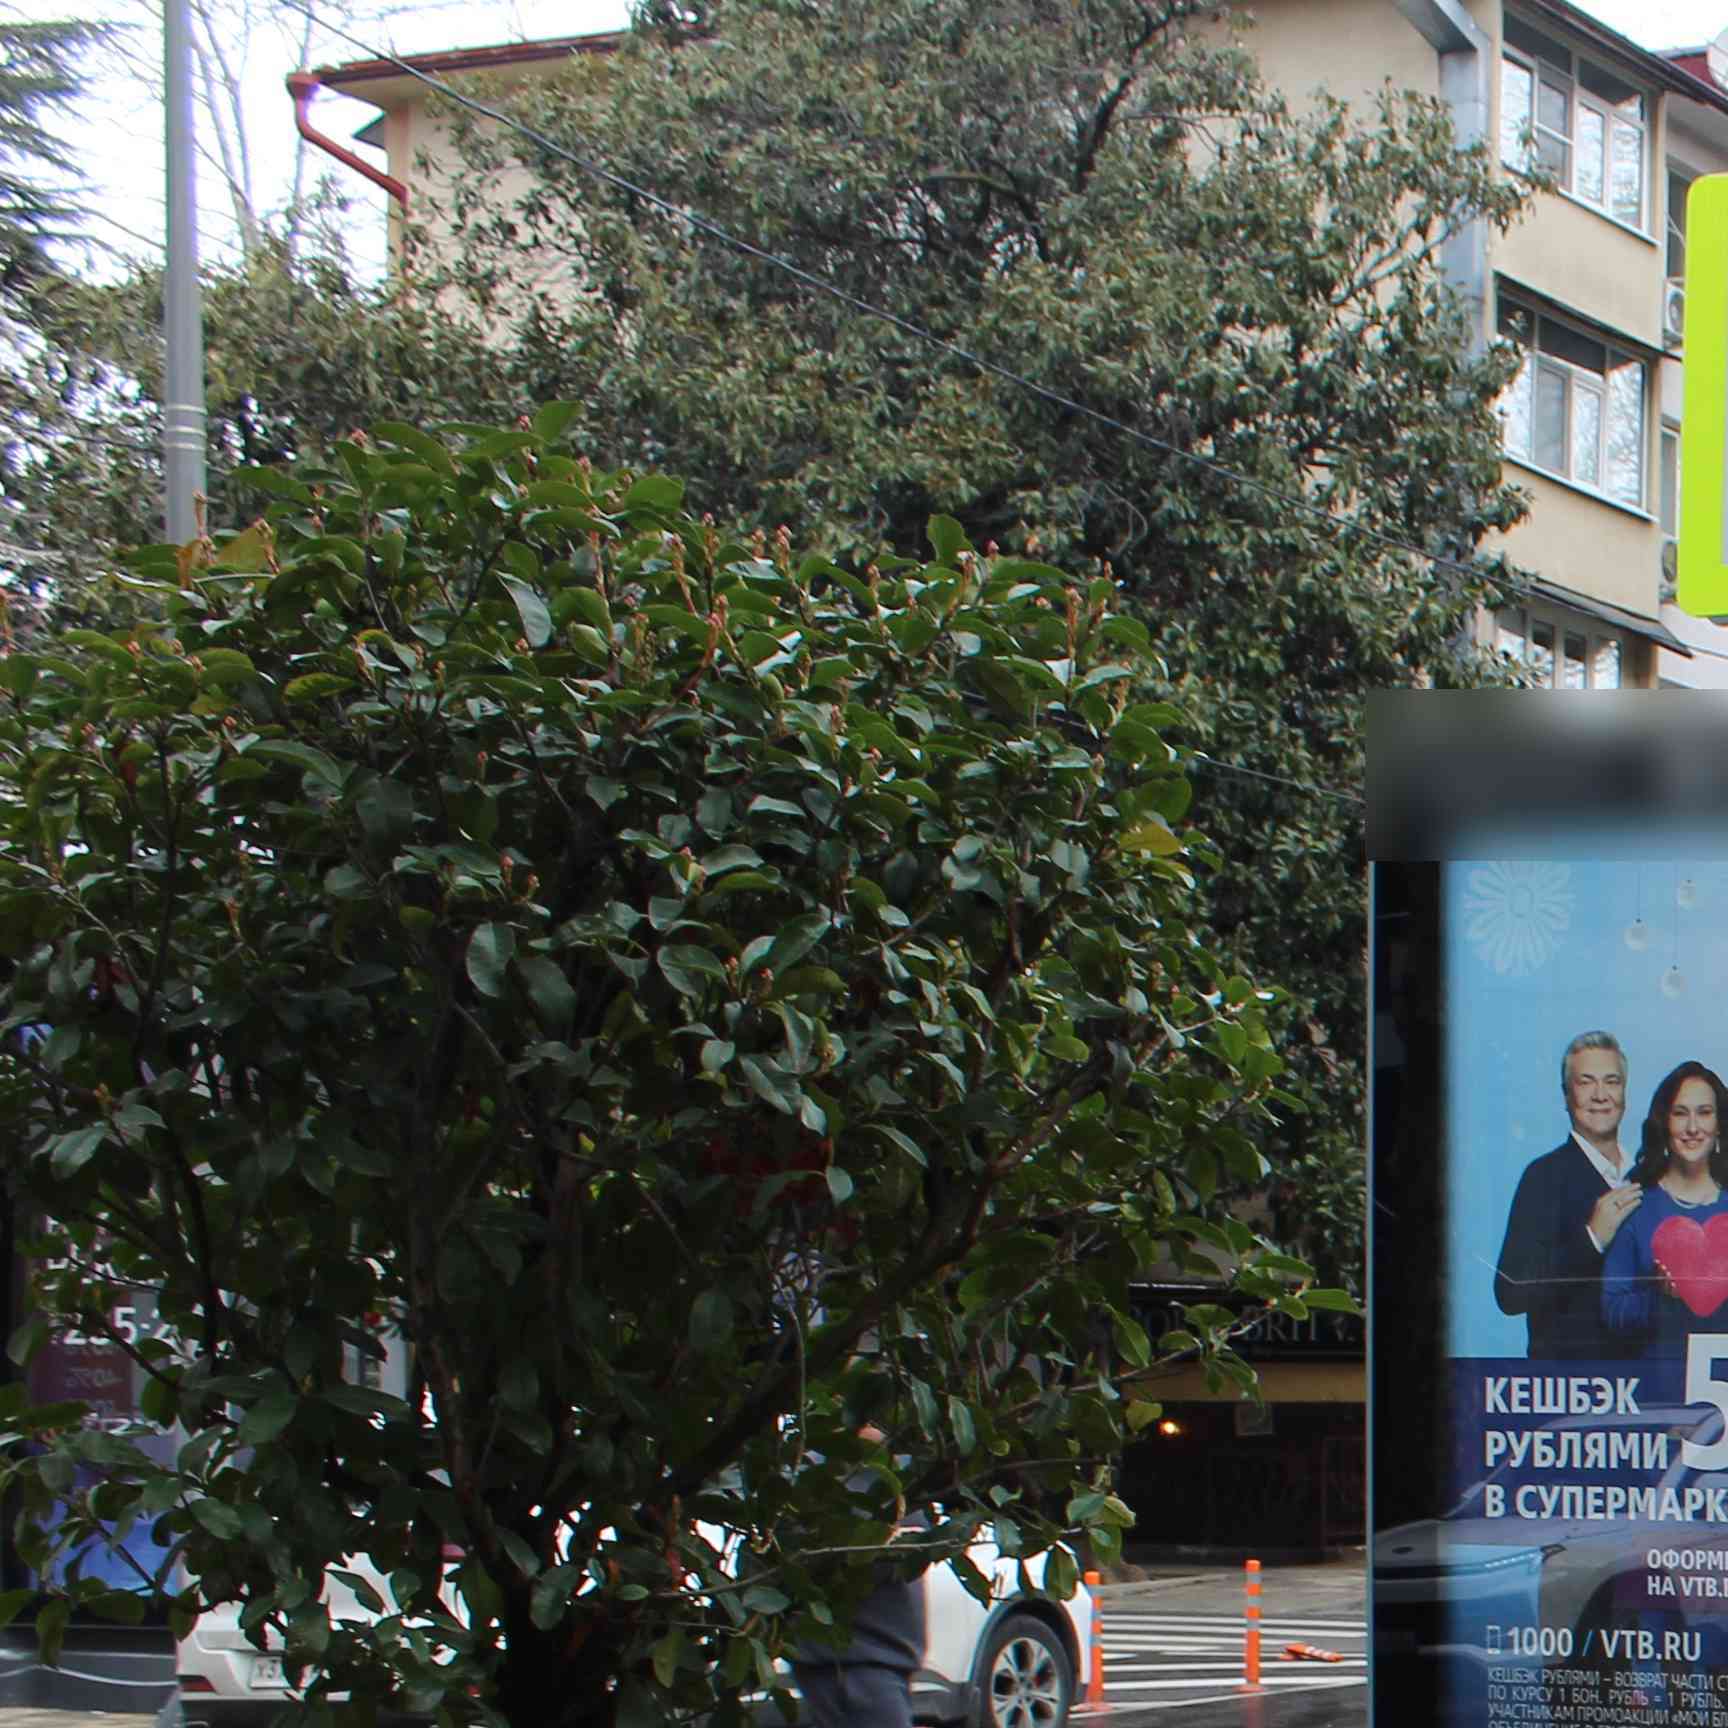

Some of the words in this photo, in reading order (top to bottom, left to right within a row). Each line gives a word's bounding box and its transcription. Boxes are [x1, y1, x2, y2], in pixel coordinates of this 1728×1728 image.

[1485, 1377, 1640, 1415] КЕШБЭК
[1485, 1431, 1668, 1470] РУБЛЯМИ
[1485, 1485, 1505, 1518] В
[1647, 1576, 1676, 1596] НА
[1508, 1626, 1574, 1657] 1000
[1582, 1630, 1594, 1658] /
[1600, 1629, 1702, 1661] VTB.RU
[1542, 1669, 1600, 1687] РУБЛЯМИ
[1613, 1672, 1669, 1689] ВОЗВРАТ
[1671, 1674, 1712, 1691] ЧАСТИ
[1487, 1684, 1505, 1701] ПО
[1511, 1685, 1552, 1702] КУРСУ
[1559, 1687, 1564, 1703] 1
[1608, 1689, 1648, 1706] РУБЛЬ
[1669, 1692, 1673, 1707] 1
[1680, 1692, 1724, 1709] РУБЛЬ.
[1487, 1704, 1574, 1722] УЧАСТНИКАМ
[1577, 1708, 1668, 1726] ПРОМОАКЦИИ
[1670, 1711, 1708, 1728] «МОИ
